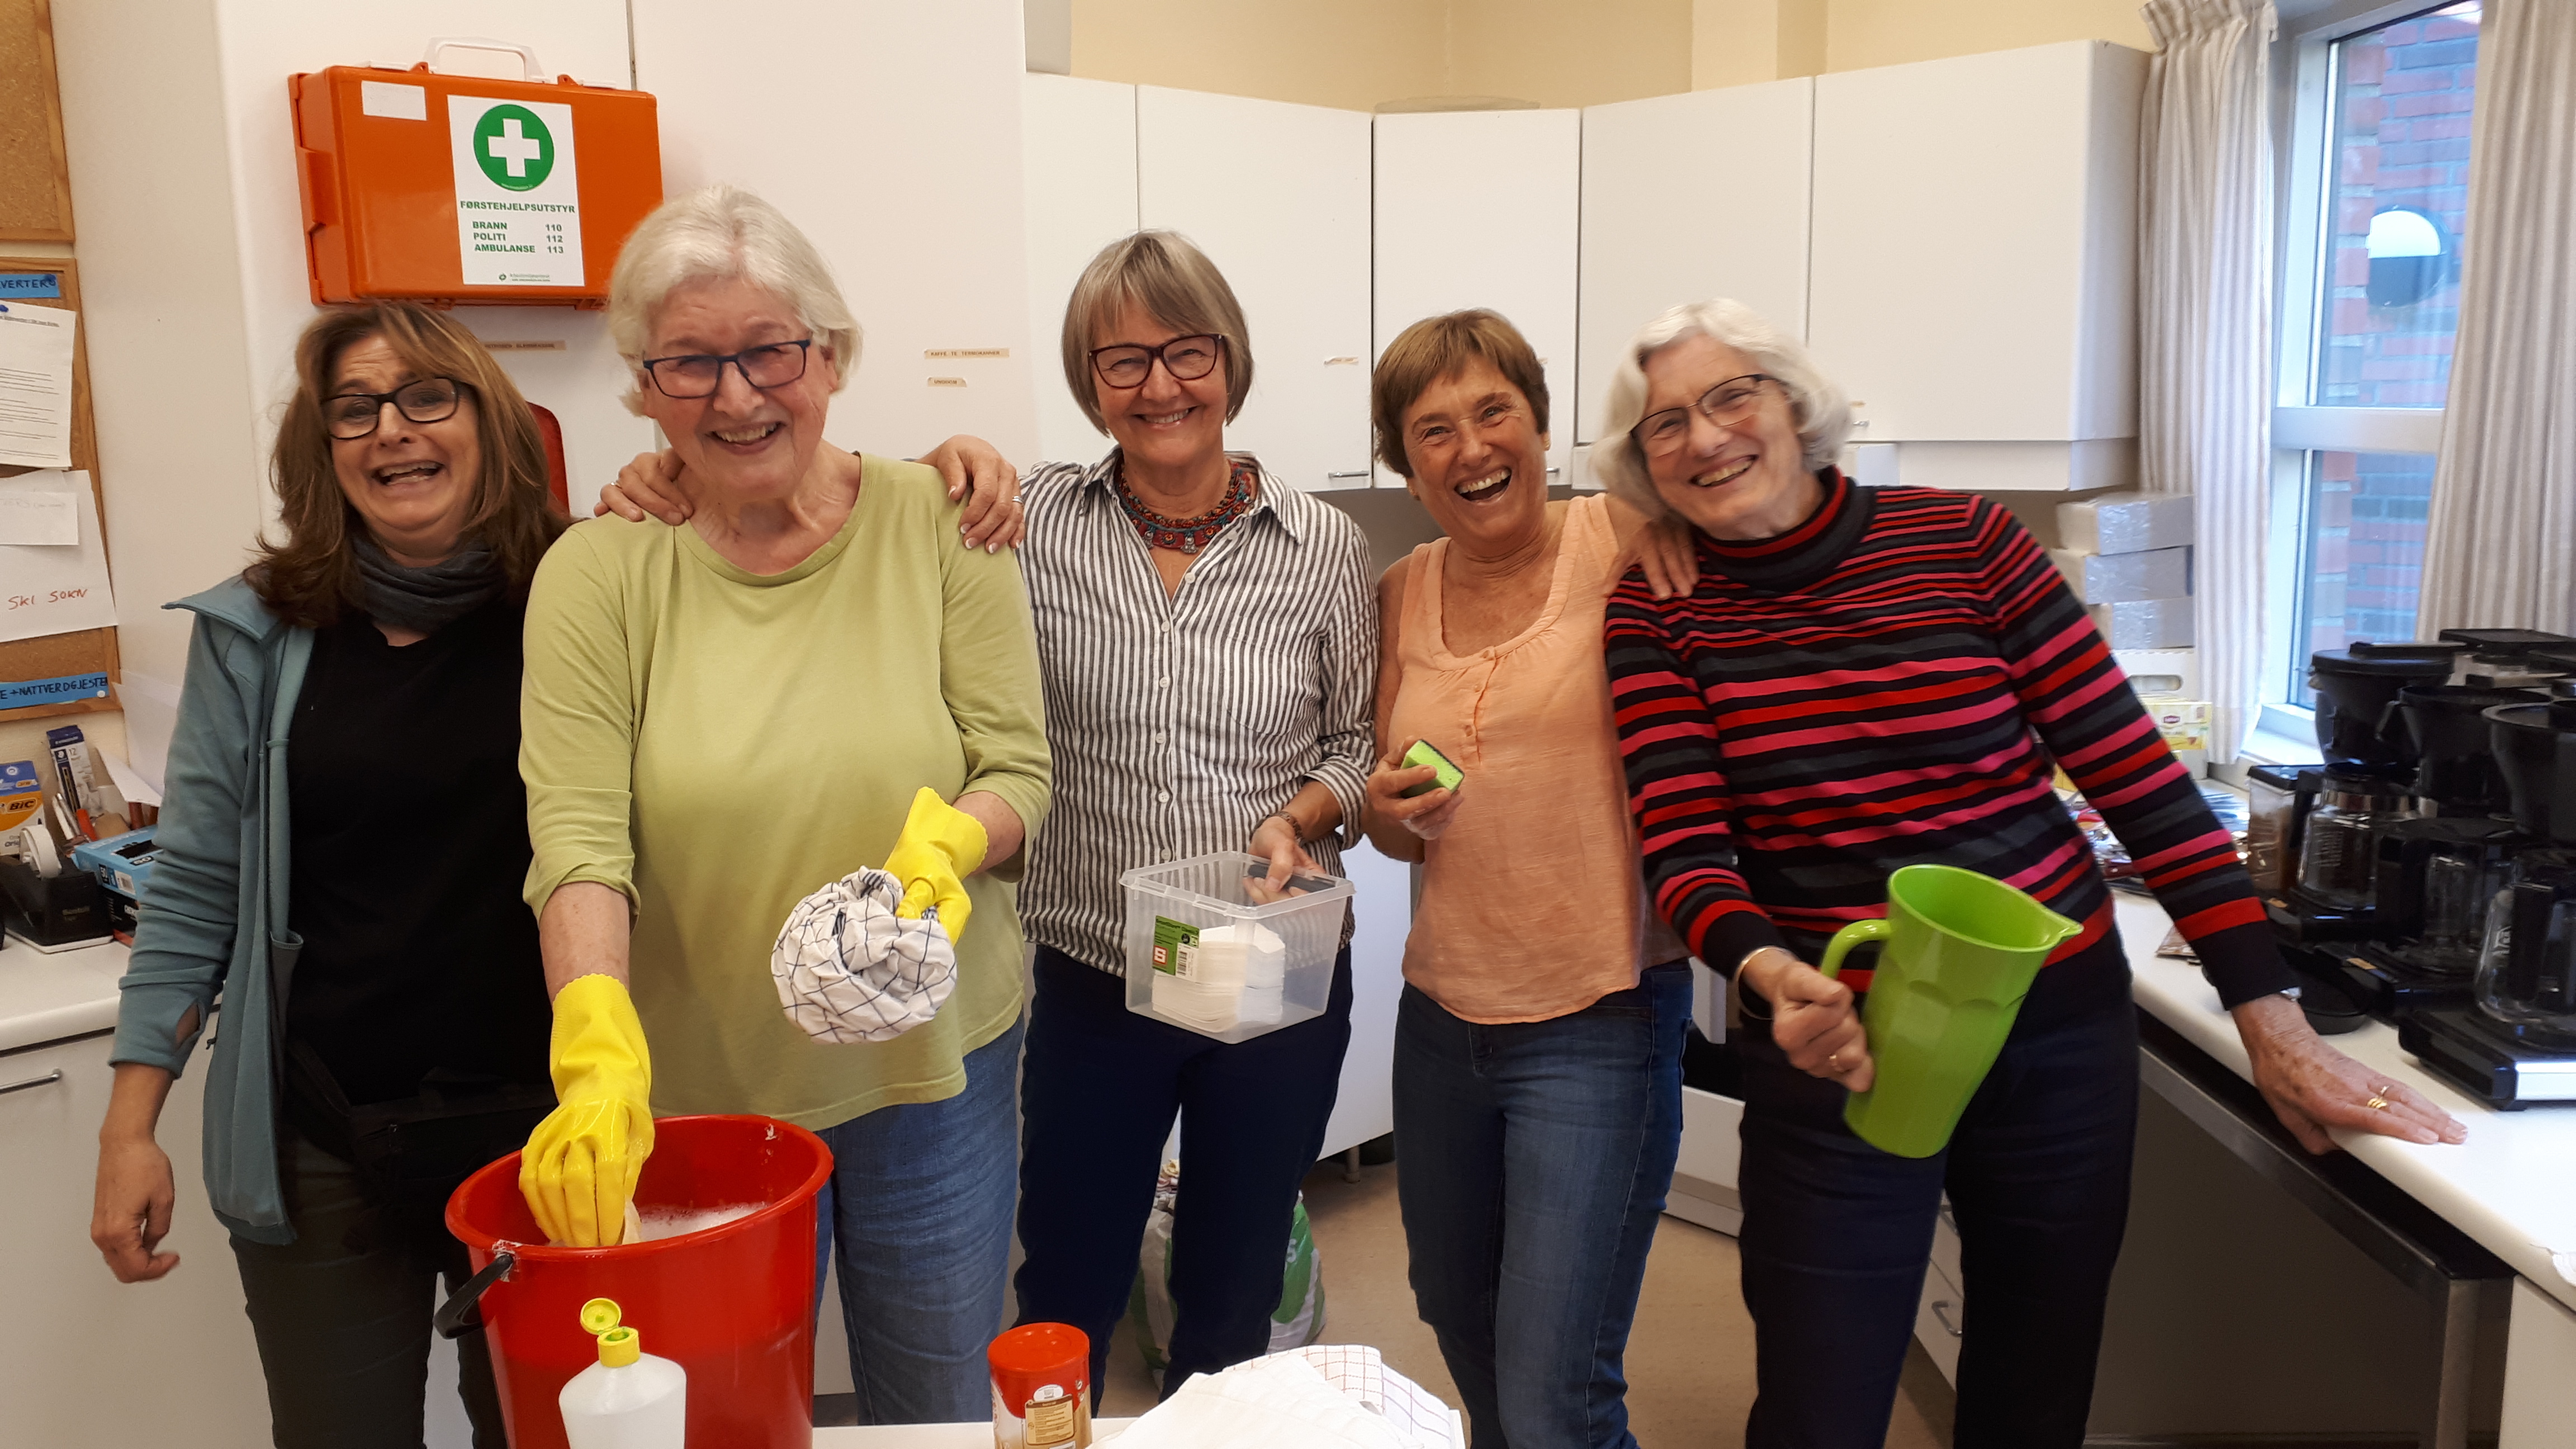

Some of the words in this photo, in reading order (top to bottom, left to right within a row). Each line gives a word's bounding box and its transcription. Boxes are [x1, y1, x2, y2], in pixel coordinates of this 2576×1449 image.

[460, 201, 576, 213] FØRSTEHJELPSUTSTYR
[472, 221, 508, 230] BRANN
[473, 232, 506, 242] POLITI
[475, 244, 536, 253] AMBULANSE
[8, 595, 35, 610] SKI
[48, 588, 88, 603] SOKN
[10, 800, 35, 811] BIC
